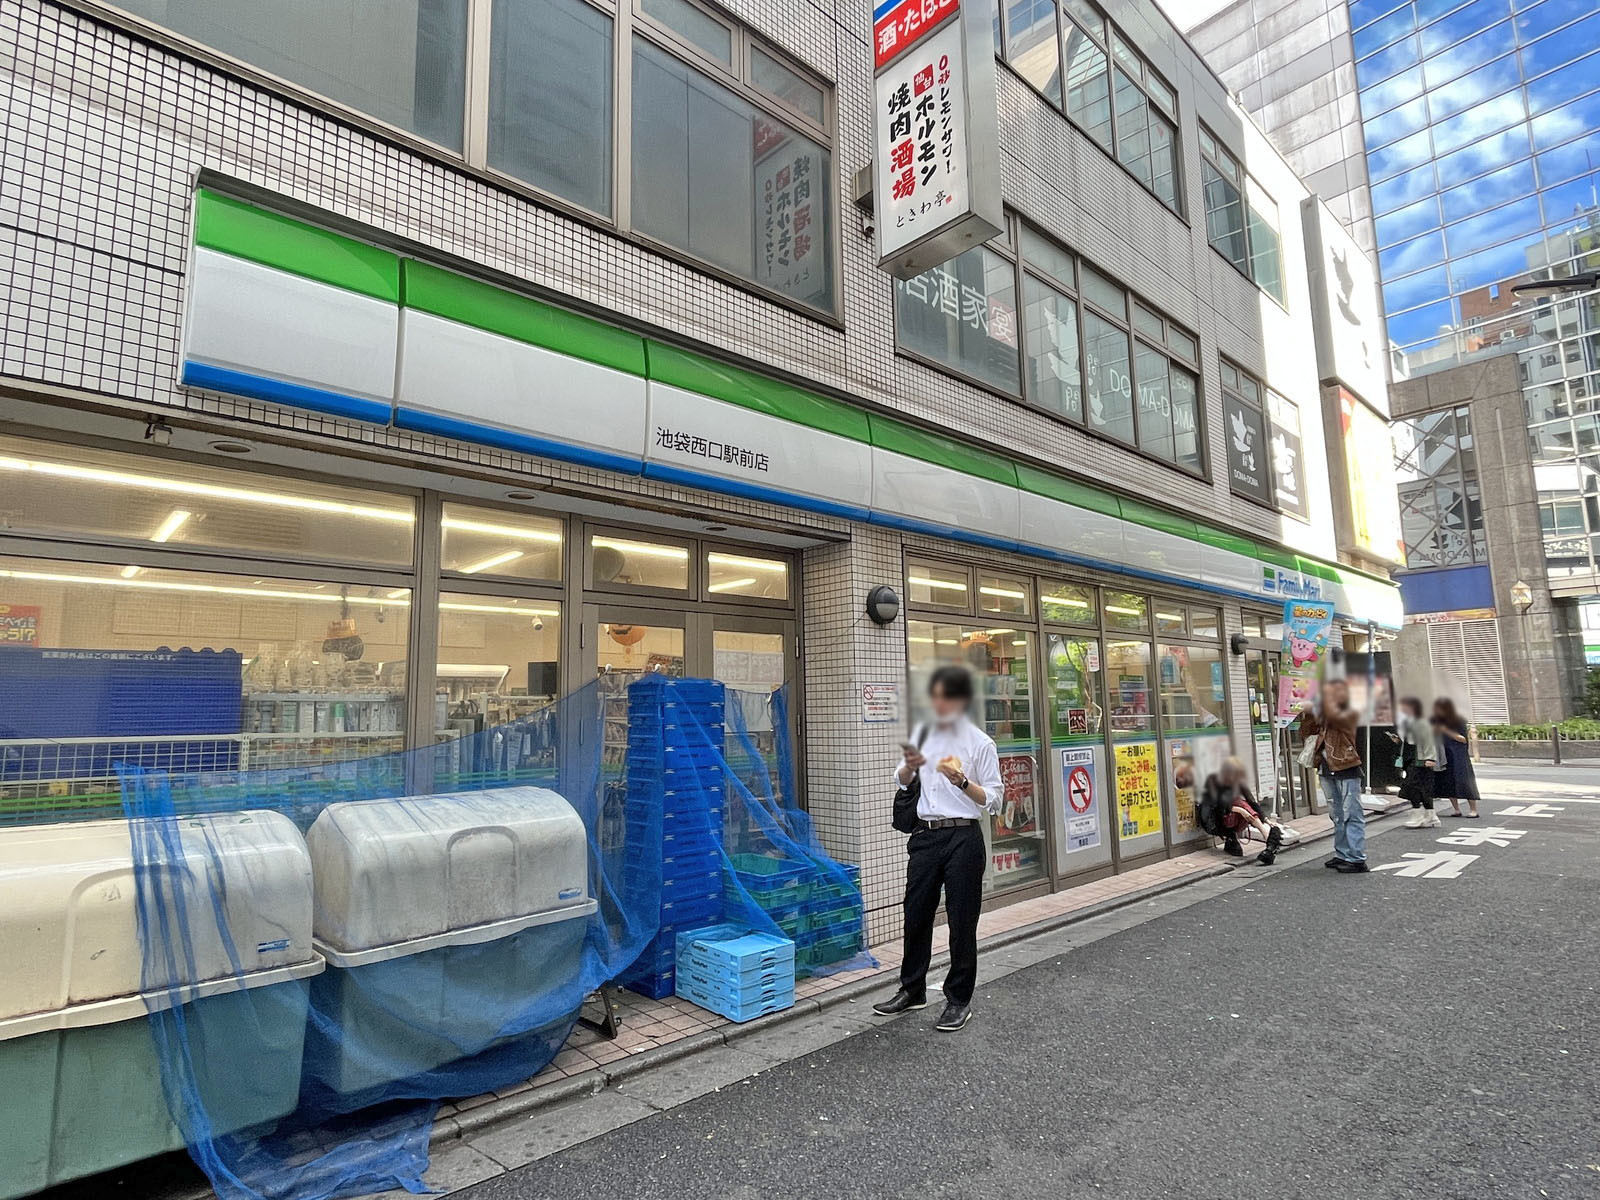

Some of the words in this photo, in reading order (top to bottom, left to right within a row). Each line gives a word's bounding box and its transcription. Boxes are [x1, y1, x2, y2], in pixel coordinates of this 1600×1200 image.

[878, 0, 952, 55] 酒・たば
[887, 82, 916, 201] 焼肉酒場
[915, 94, 937, 187] ホルモン
[896, 190, 947, 228] ときわ亭
[990, 304, 1013, 342] 宴
[655, 426, 769, 472] 池袋西口駅前店
[1121, 790, 1158, 807] ご協力下さい
